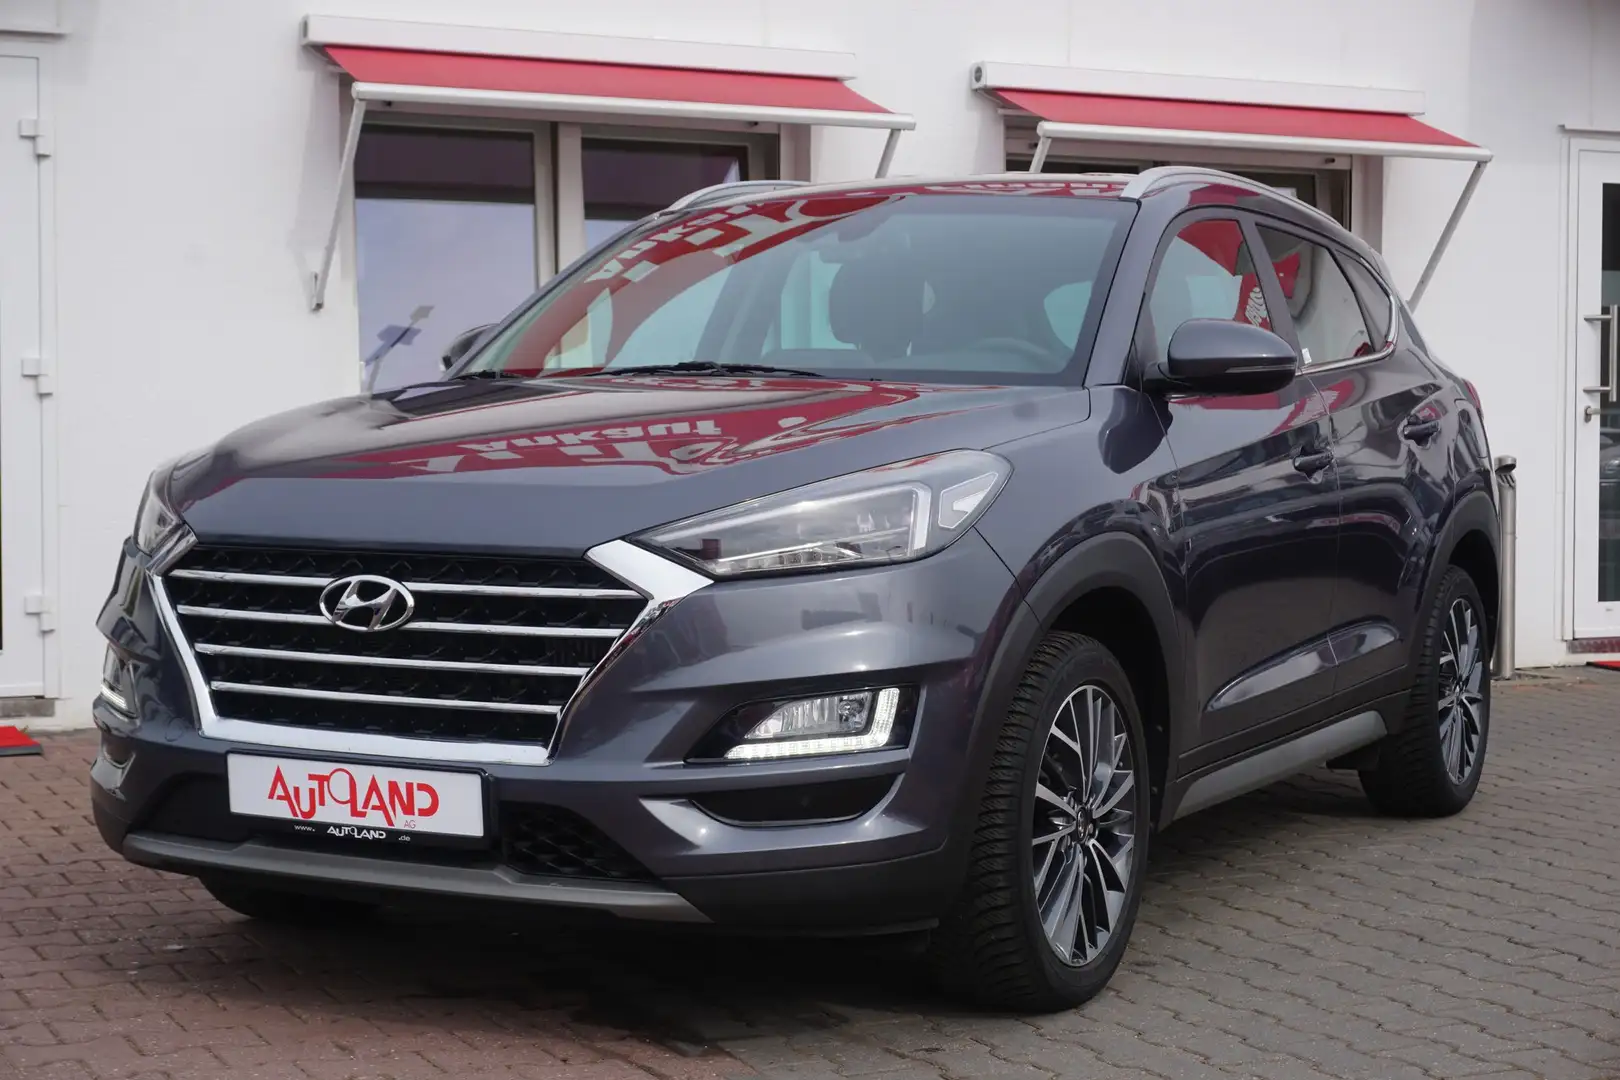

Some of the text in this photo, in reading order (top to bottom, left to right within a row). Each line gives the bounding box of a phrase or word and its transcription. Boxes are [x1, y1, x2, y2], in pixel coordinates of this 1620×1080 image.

[268, 765, 439, 827] AUTOLAND
[404, 820, 416, 829] AG
[327, 826, 386, 840] AUTOLAND
